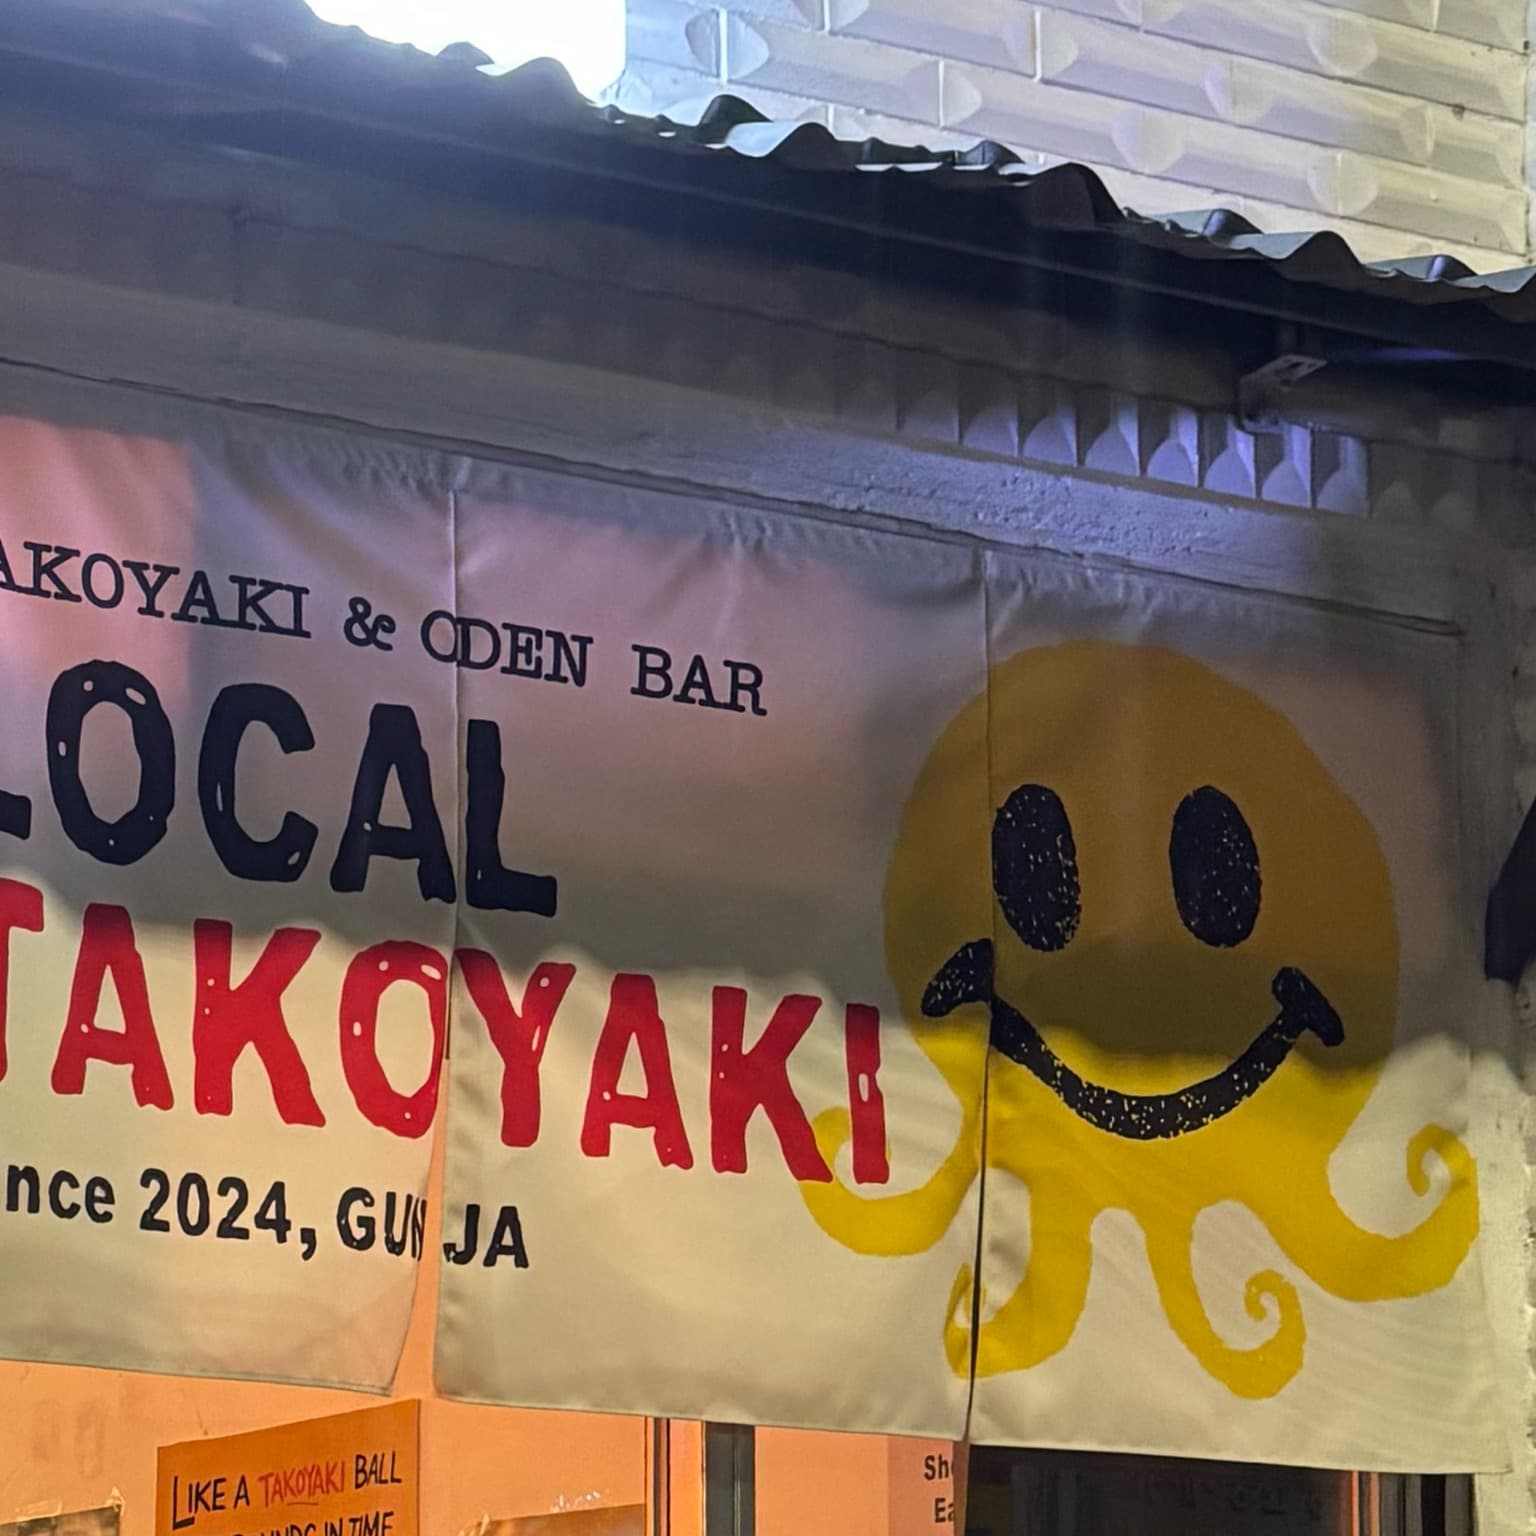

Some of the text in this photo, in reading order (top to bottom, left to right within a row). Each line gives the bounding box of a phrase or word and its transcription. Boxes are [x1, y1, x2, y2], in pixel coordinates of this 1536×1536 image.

[343, 597, 396, 652] &
[420, 610, 594, 688] ODEN
[630, 644, 769, 716] BAR
[138, 1167, 318, 1262] 2024,
[171, 1450, 402, 1530] LIKE A TAKOYAKI BALL
[924, 1454, 954, 1481] Sh
